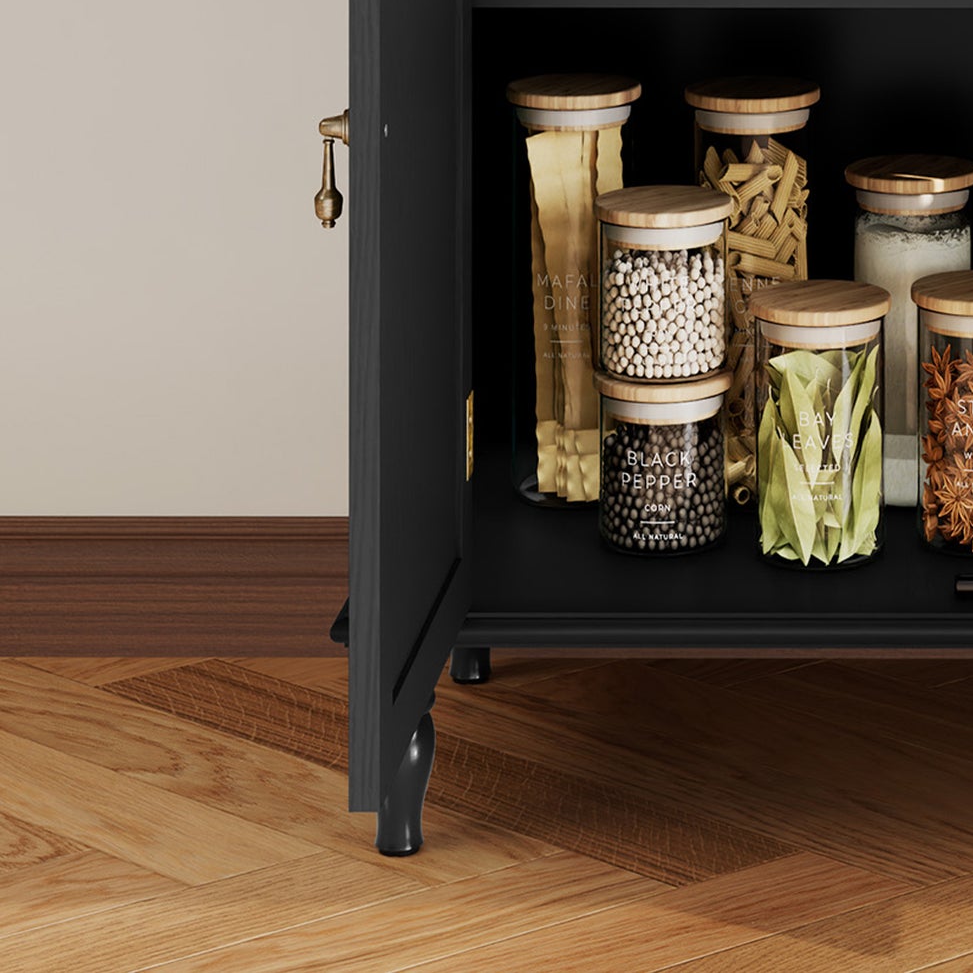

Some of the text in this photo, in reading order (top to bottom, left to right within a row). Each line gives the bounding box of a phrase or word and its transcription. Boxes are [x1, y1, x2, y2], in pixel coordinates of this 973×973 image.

[543, 295, 590, 310] DINE
[799, 411, 837, 427] BAY
[782, 430, 854, 450] LEAVES
[627, 450, 692, 468] BLACK
[621, 472, 697, 490] PEPPER
[644, 504, 671, 512] CORN
[633, 533, 684, 541] ALL NATURAL
